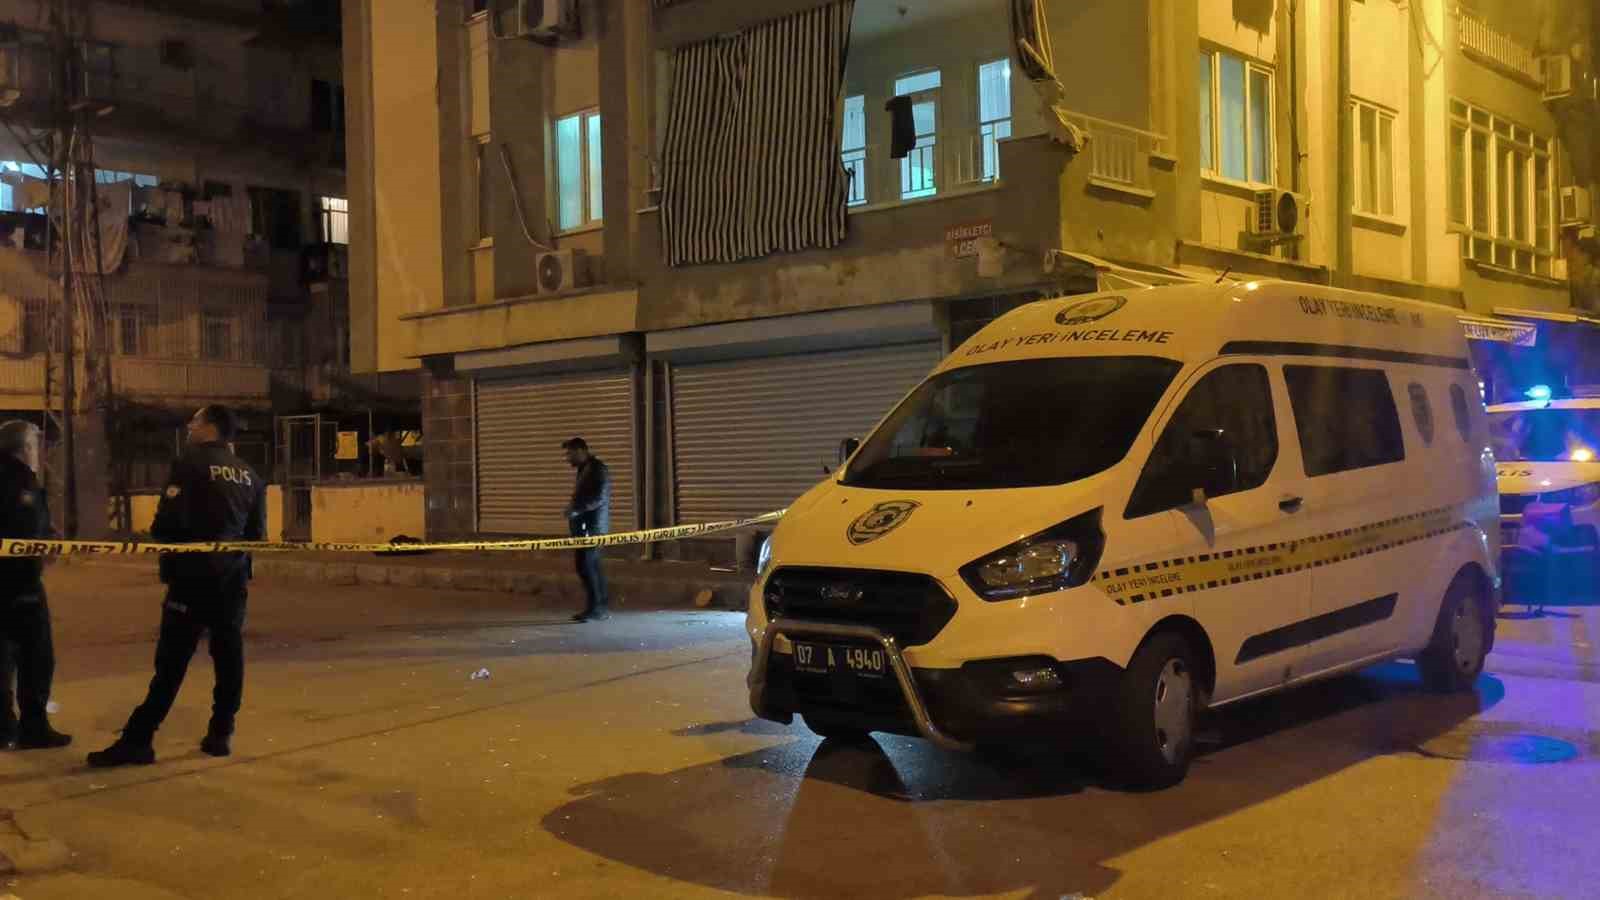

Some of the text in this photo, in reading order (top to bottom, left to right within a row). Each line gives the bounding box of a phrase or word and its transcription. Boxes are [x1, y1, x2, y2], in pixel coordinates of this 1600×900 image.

[966, 337, 1014, 356] OLAY
[798, 644, 881, 671] 07 A 4940
